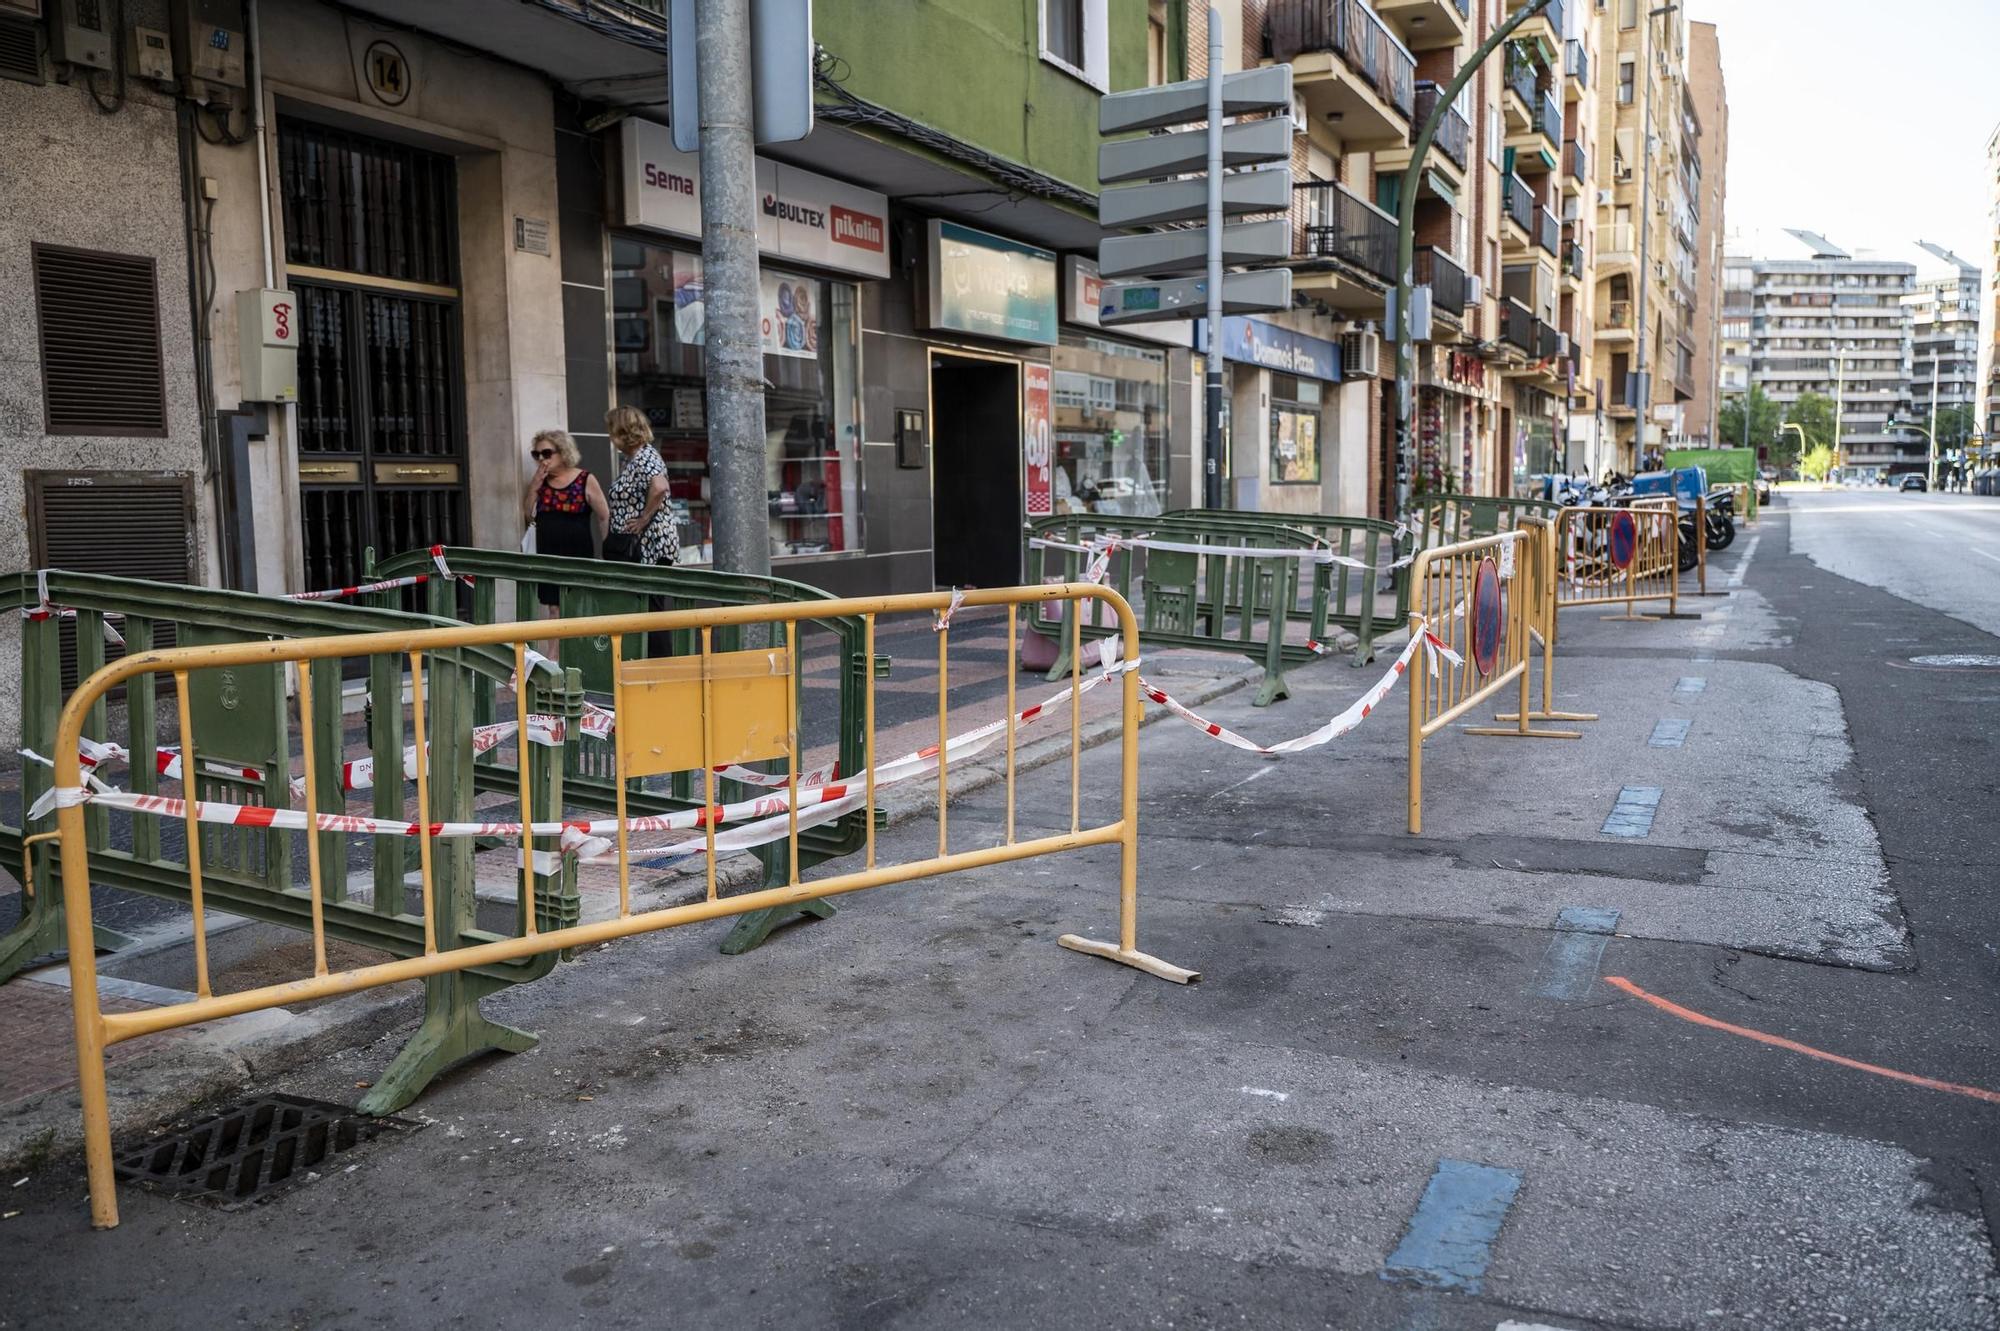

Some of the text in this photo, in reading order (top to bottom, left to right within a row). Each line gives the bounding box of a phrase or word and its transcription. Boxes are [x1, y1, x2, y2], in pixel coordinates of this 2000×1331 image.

[376, 57, 400, 91] 14
[644, 162, 695, 197] Sema
[778, 202, 825, 229] BULTEX
[834, 214, 880, 243] pikolin
[1253, 335, 1292, 369] Domino's
